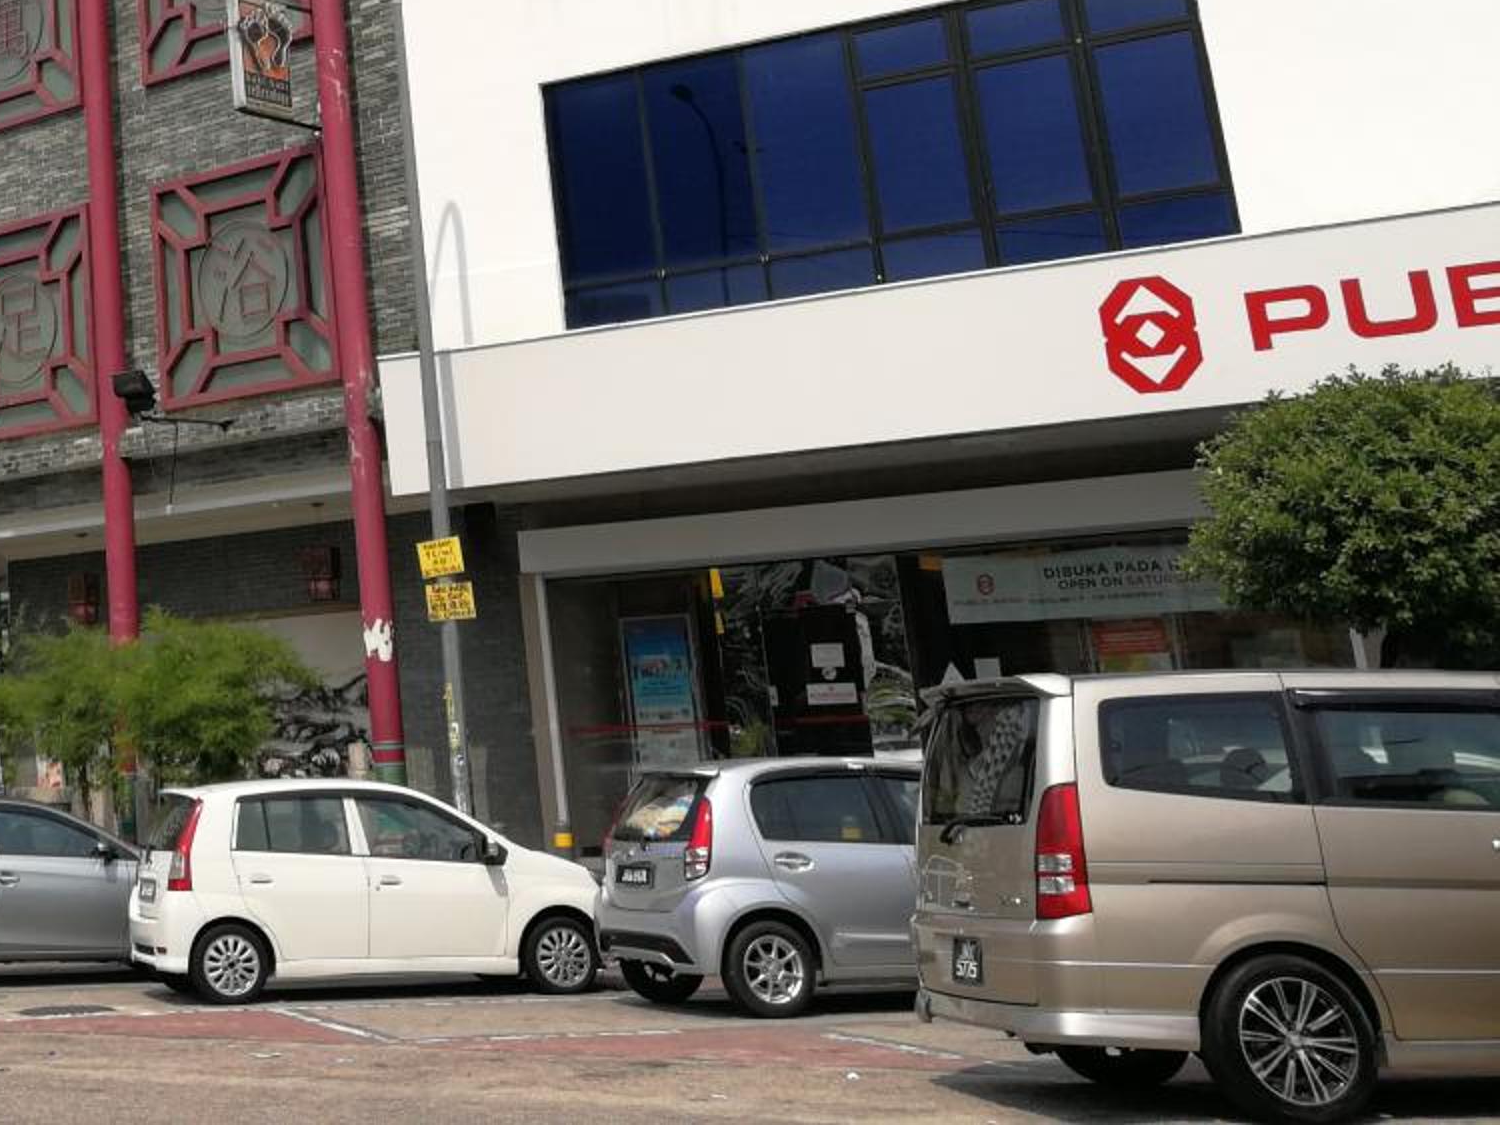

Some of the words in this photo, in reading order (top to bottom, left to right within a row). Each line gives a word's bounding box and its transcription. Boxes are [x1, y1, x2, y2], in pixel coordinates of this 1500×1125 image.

[1043, 562, 1109, 579] DIBUKA
[1114, 559, 1162, 574] PADA
[1058, 578, 1097, 590] OPEN
[1102, 577, 1124, 588] ON
